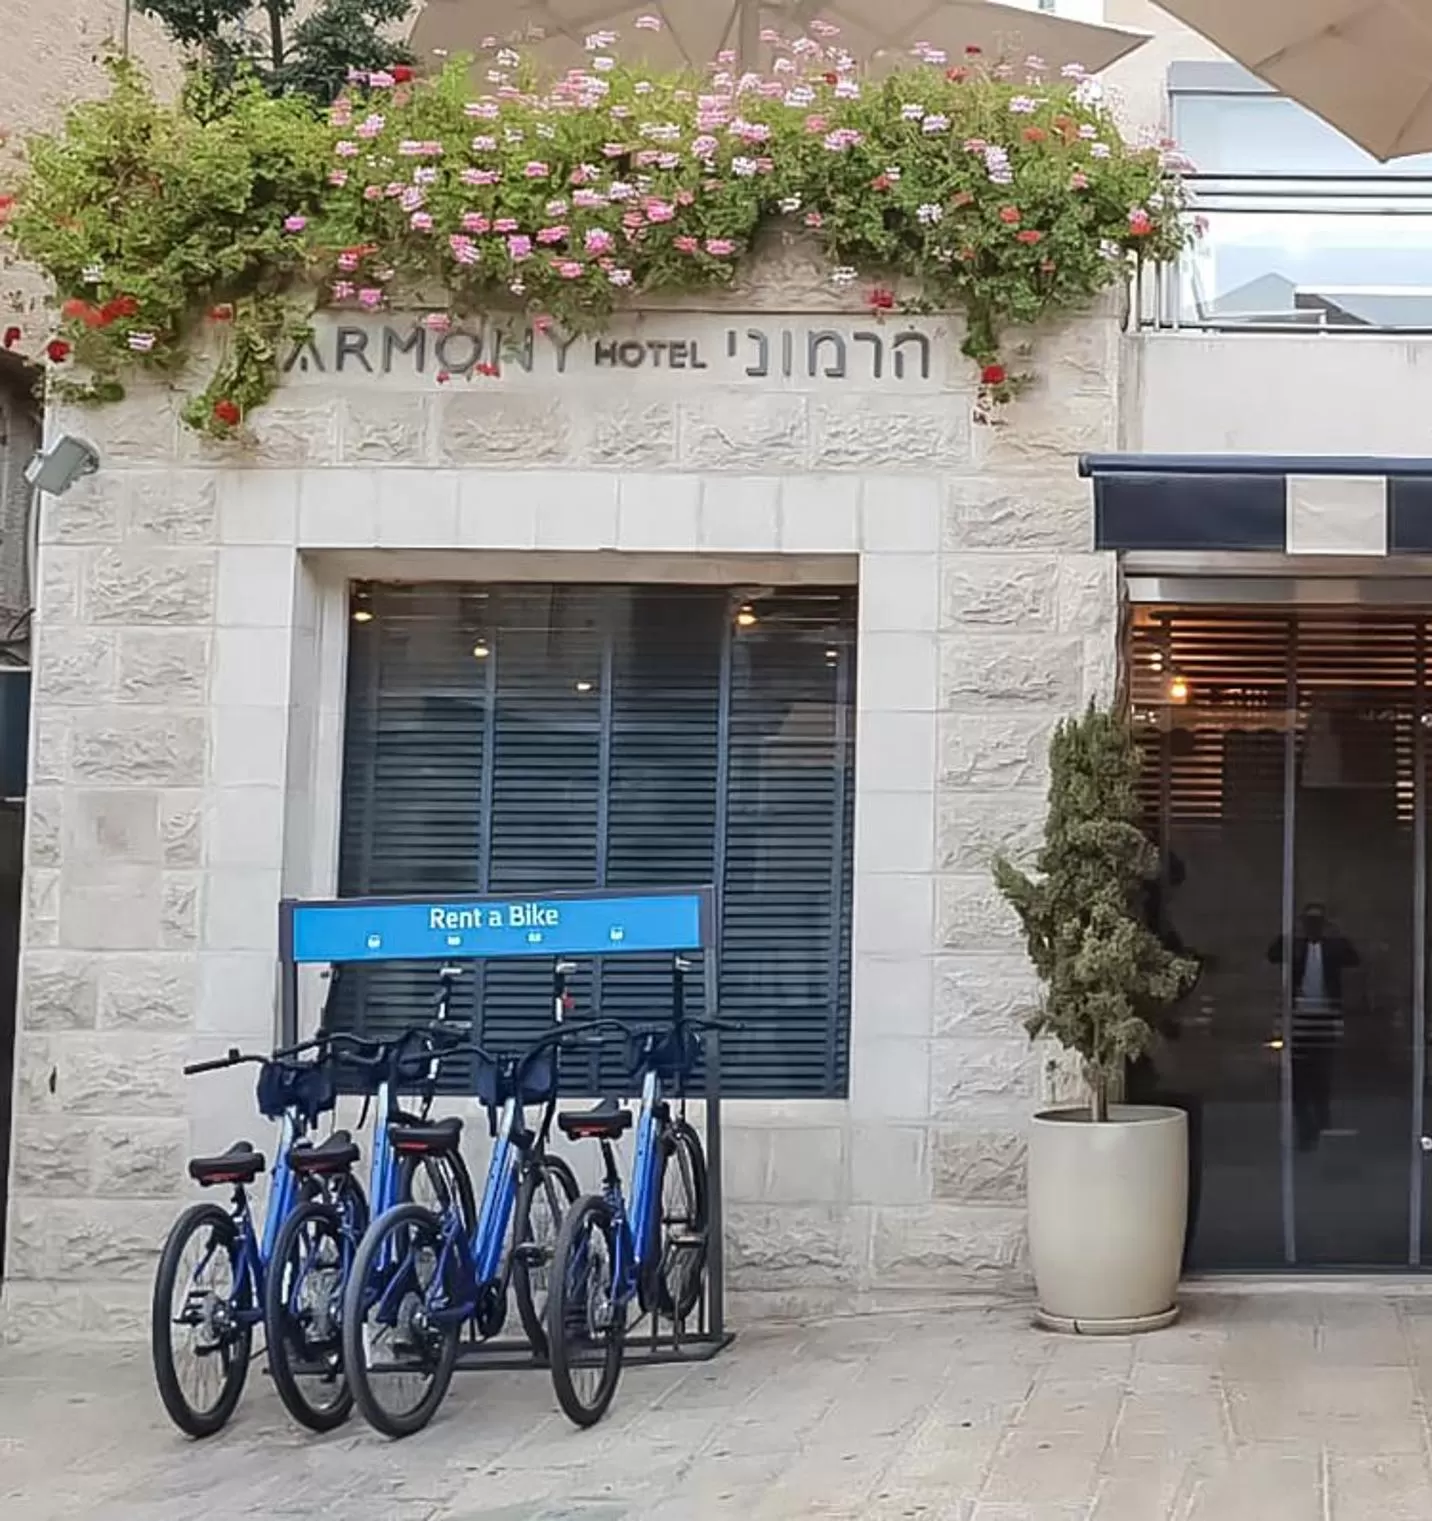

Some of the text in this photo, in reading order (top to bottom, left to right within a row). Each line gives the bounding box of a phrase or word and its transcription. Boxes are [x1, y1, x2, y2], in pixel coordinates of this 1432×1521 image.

[282, 325, 708, 374] ARMONY HOTEL
[726, 329, 931, 379] הרמוני
[429, 903, 559, 929] Rent a Bike
